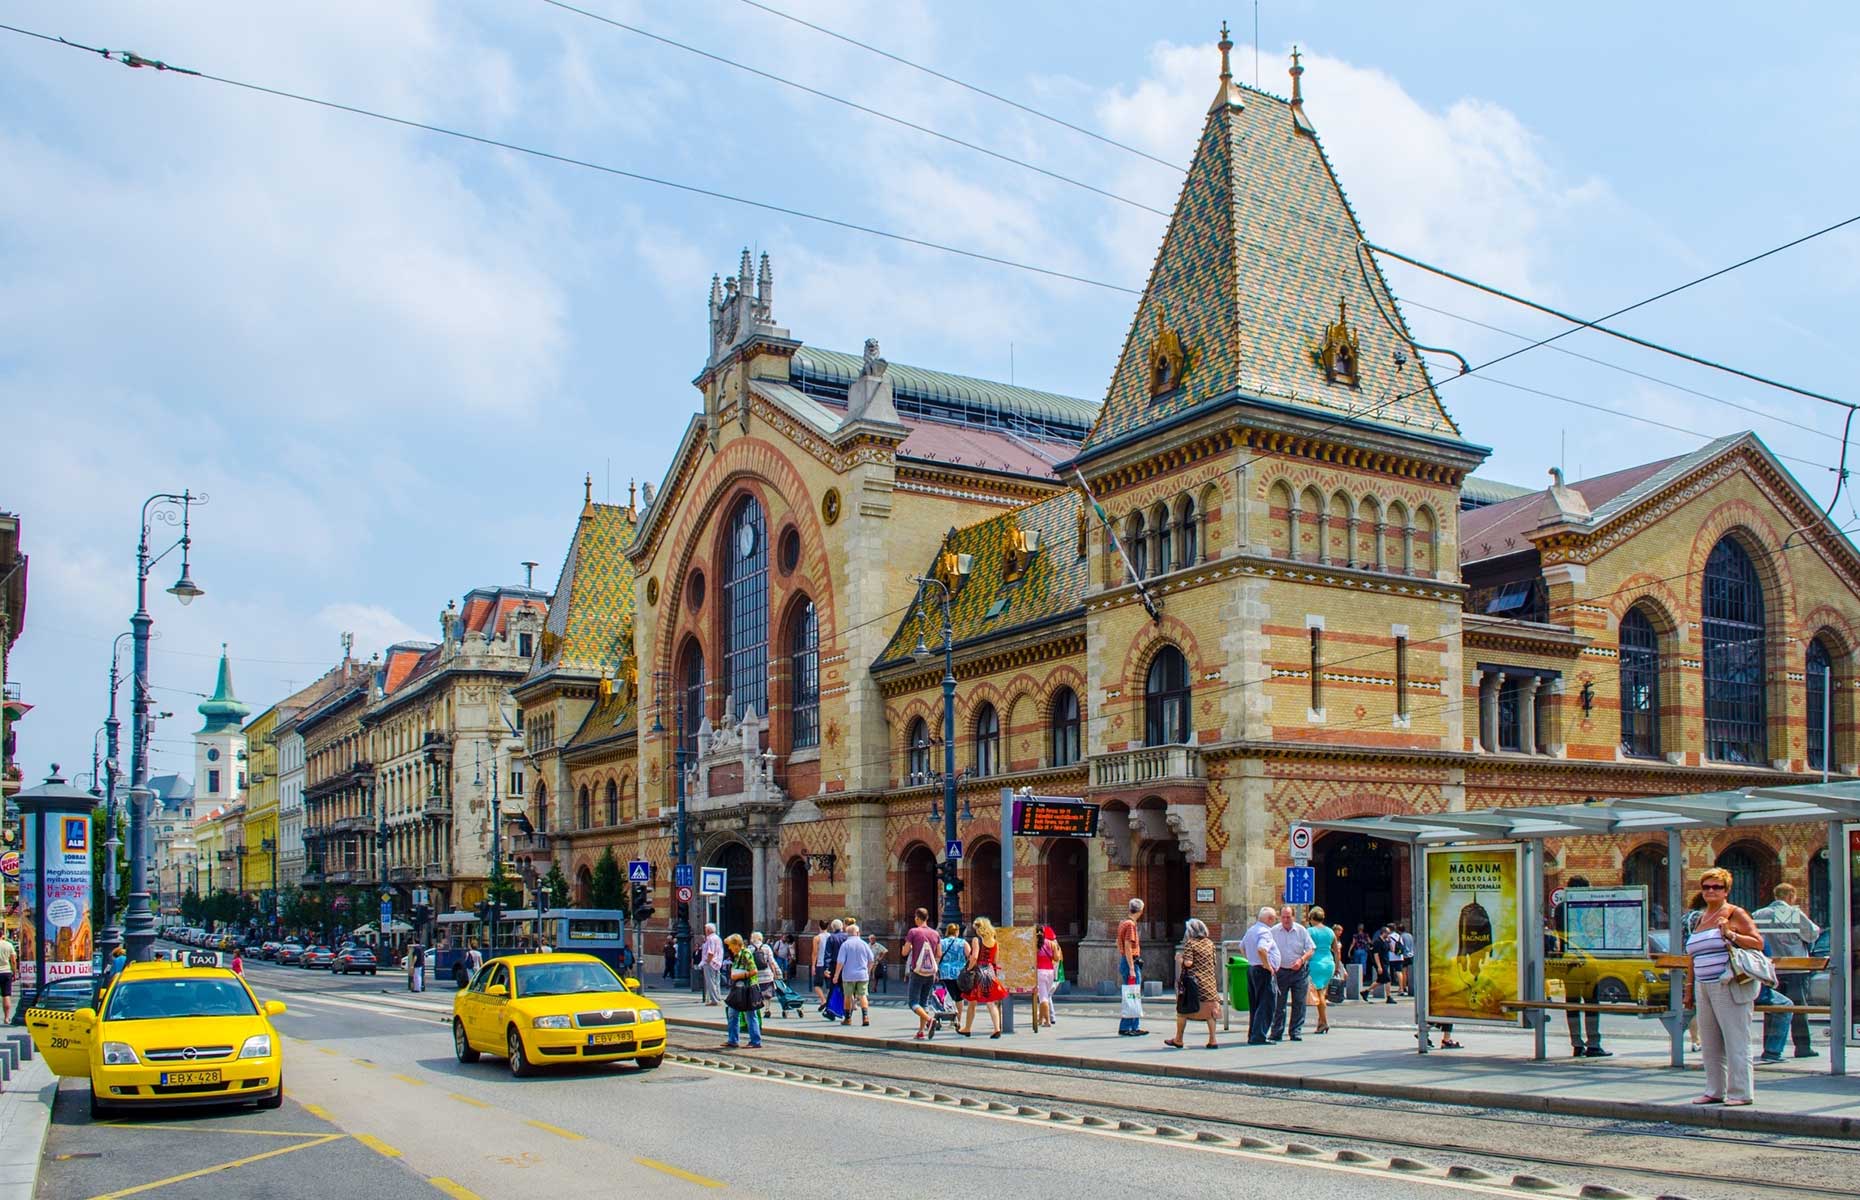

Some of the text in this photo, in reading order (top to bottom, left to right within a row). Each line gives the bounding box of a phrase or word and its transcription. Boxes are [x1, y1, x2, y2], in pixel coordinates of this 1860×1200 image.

[3, 861, 19, 872] KIN
[1449, 864, 1501, 873] MAGNUM
[191, 956, 215, 964] TAXI
[49, 965, 75, 974] ALDI
[51, 1037, 69, 1048] 280
[170, 1071, 218, 1084] EBX-428
